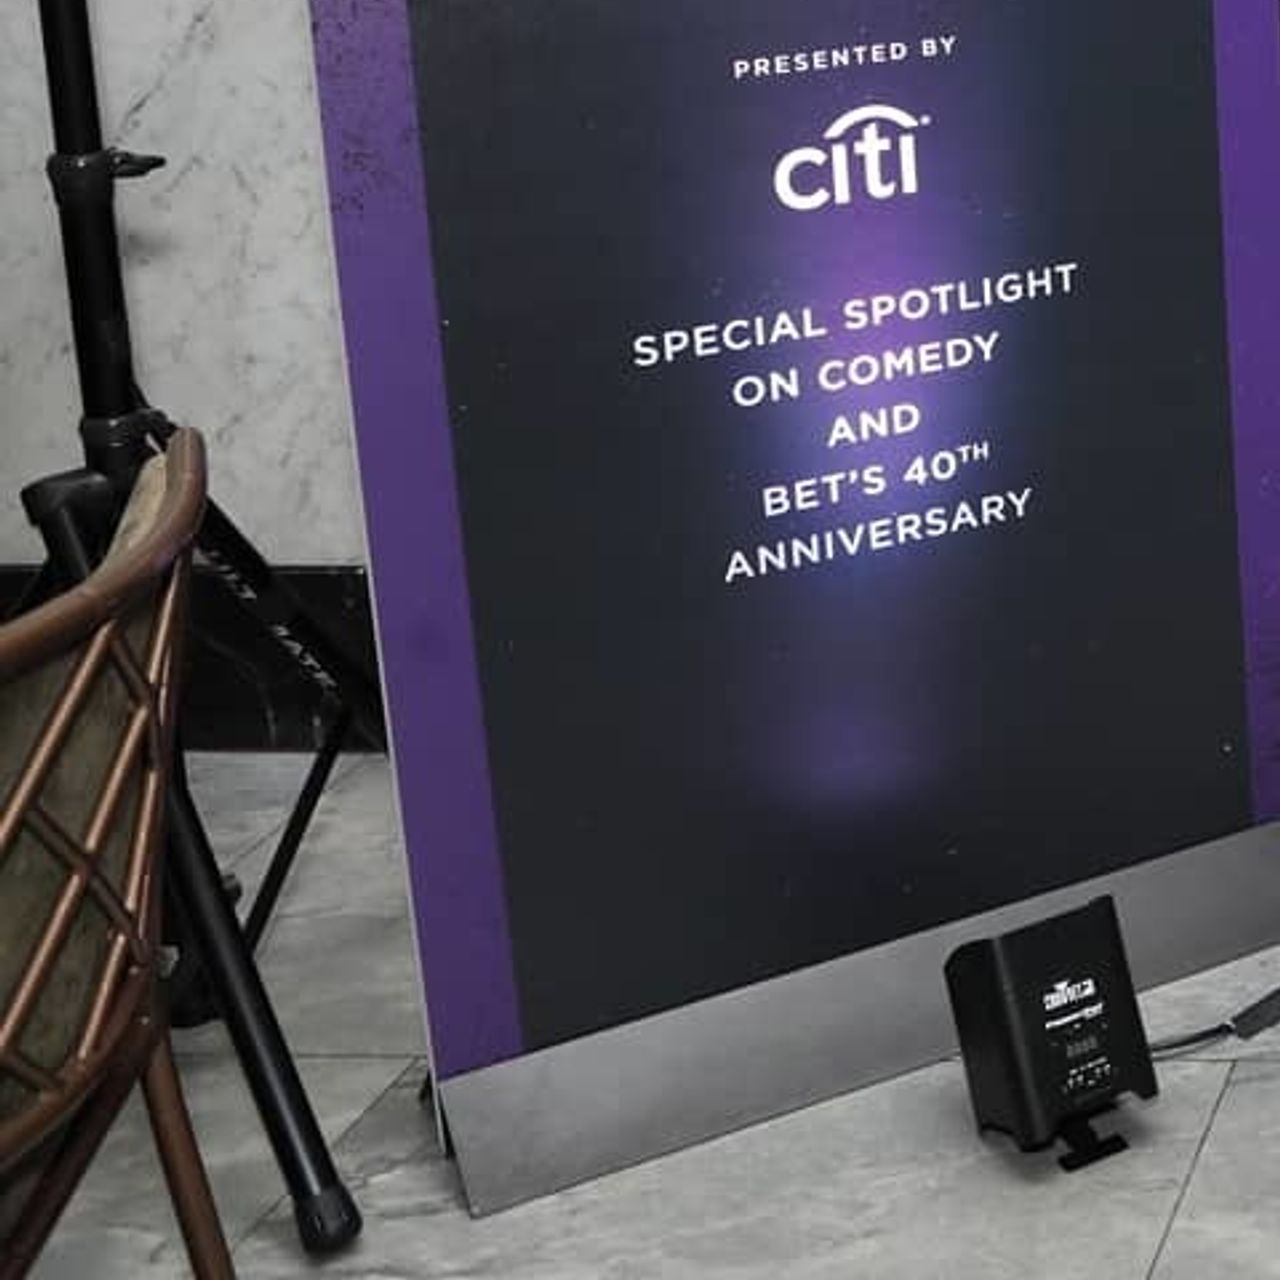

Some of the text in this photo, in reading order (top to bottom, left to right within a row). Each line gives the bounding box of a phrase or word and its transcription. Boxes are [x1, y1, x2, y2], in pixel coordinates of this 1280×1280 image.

[732, 35, 958, 80] PRESENTED BY
[773, 103, 922, 211] citi
[633, 262, 1079, 367] SPECIAL SPOTLIGHT
[732, 331, 1002, 408] ON COMEDY
[827, 403, 922, 448] AND
[763, 441, 991, 518] BET'S 40TH
[724, 487, 1034, 584] ANNIVERSARY
